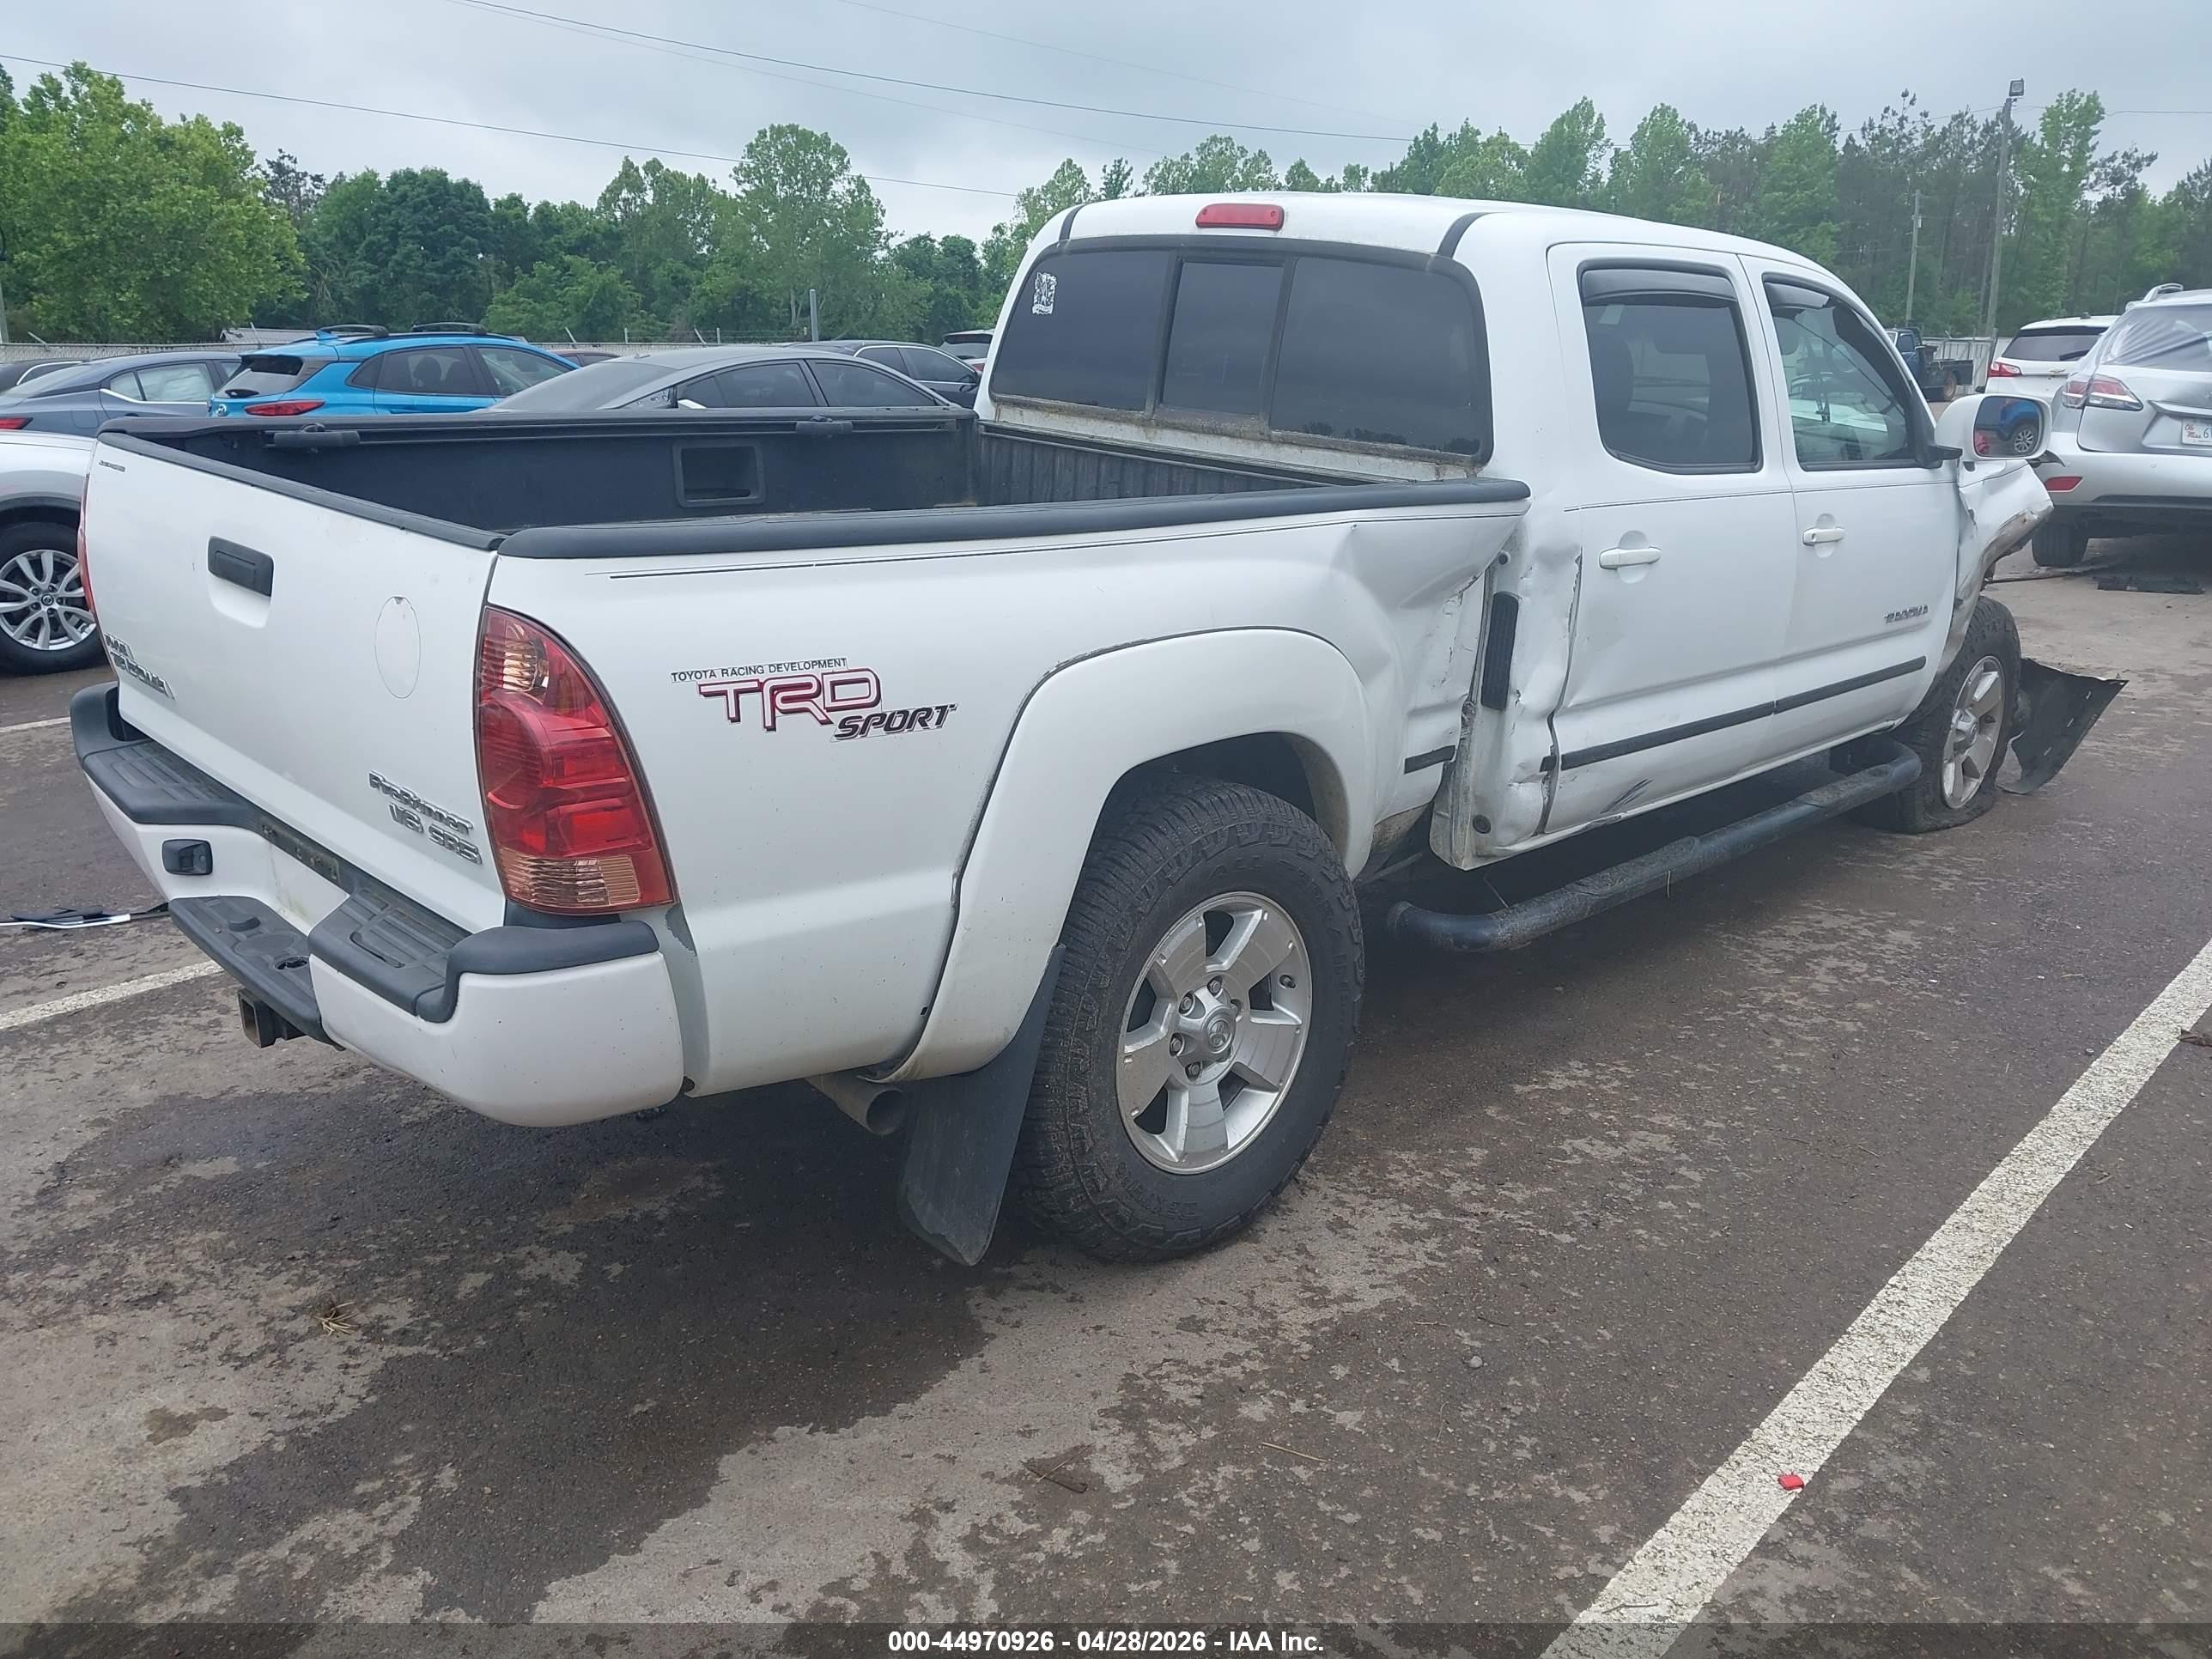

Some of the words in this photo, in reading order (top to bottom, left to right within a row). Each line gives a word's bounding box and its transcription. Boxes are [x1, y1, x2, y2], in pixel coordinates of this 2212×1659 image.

[2203, 427, 2212, 439] 6
[671, 669, 717, 683] TOYOTA
[720, 664, 765, 678] RACING
[768, 657, 848, 674] DEVELOPMENT
[698, 668, 882, 732] TRD
[834, 703, 958, 741] SPORT
[389, 803, 424, 834] V6
[428, 823, 483, 866] SR5
